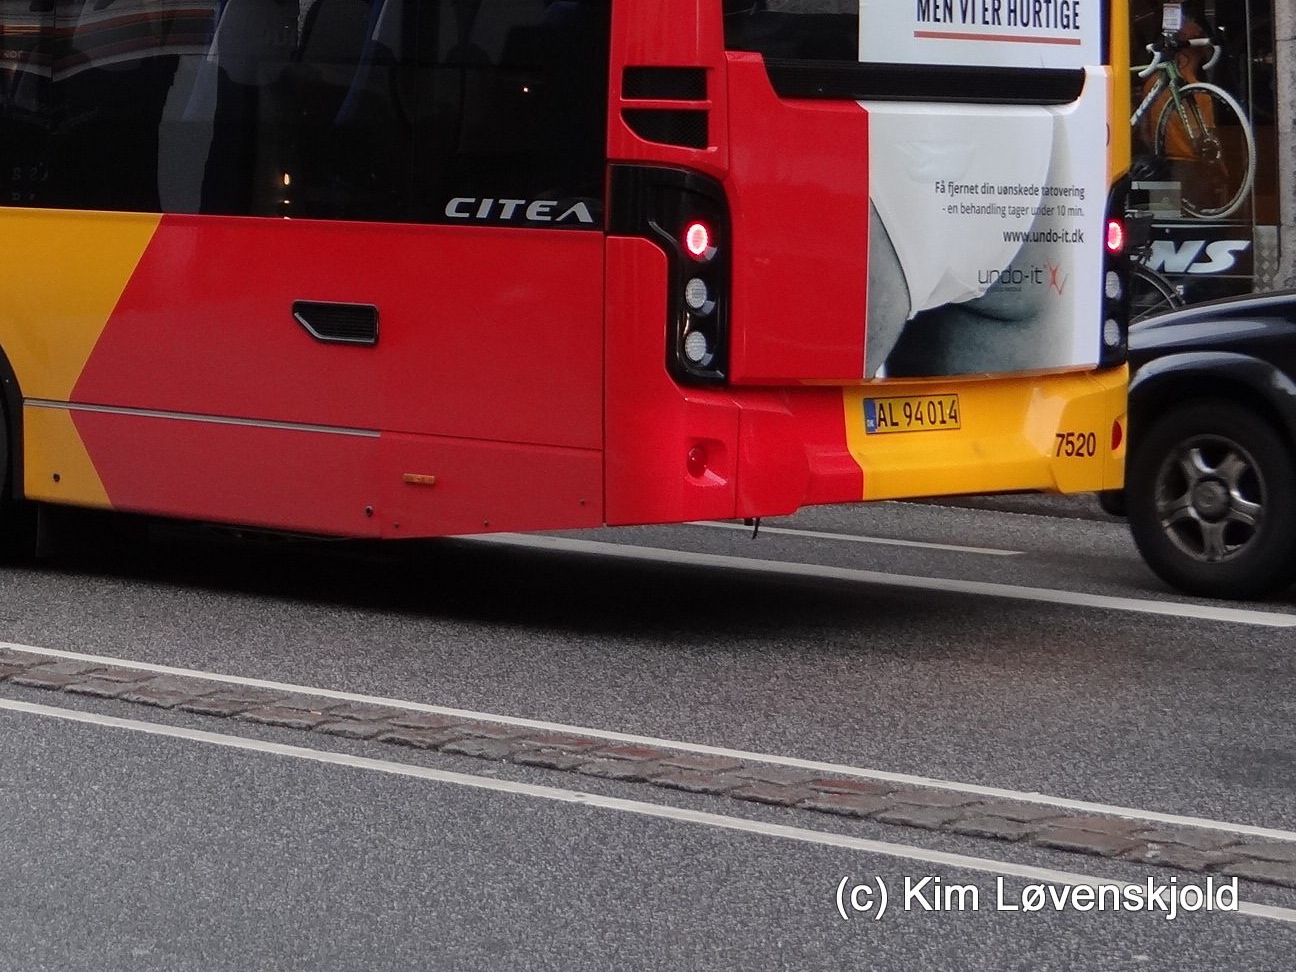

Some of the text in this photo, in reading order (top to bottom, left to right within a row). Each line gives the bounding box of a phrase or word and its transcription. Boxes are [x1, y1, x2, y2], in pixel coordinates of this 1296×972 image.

[935, 179, 1085, 201] Få fjernet din uønskede tatovering
[444, 197, 594, 224] CITEA
[947, 203, 959, 215] en
[960, 202, 1006, 219] behandling
[1008, 204, 1029, 219] tager
[1031, 204, 1055, 216] under
[1057, 204, 1066, 216] 10
[1067, 205, 1085, 217] min.
[1003, 228, 1085, 244] www.undo-it.dk
[978, 265, 1043, 285] undo-it
[878, 402, 899, 427] AL
[1055, 431, 1097, 458] 7520
